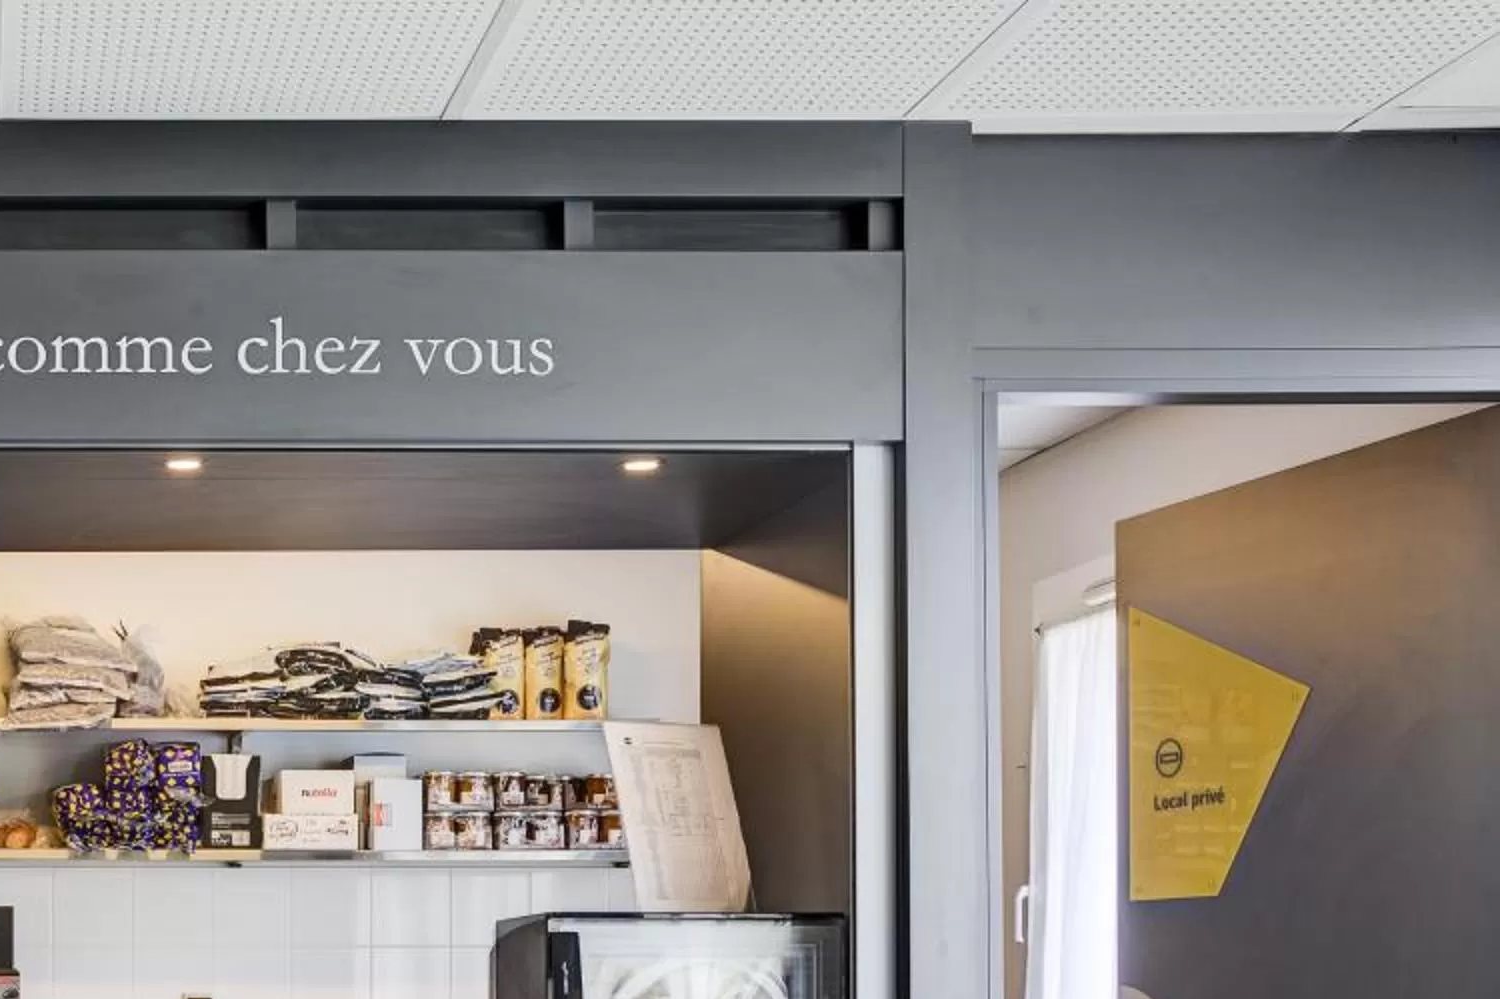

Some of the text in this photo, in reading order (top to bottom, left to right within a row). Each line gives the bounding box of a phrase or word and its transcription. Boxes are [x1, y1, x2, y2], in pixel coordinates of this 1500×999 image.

[237, 315, 381, 376] chez
[402, 336, 555, 377] vous
[301, 787, 339, 800] nutella
[1153, 785, 1225, 812] Local privé
